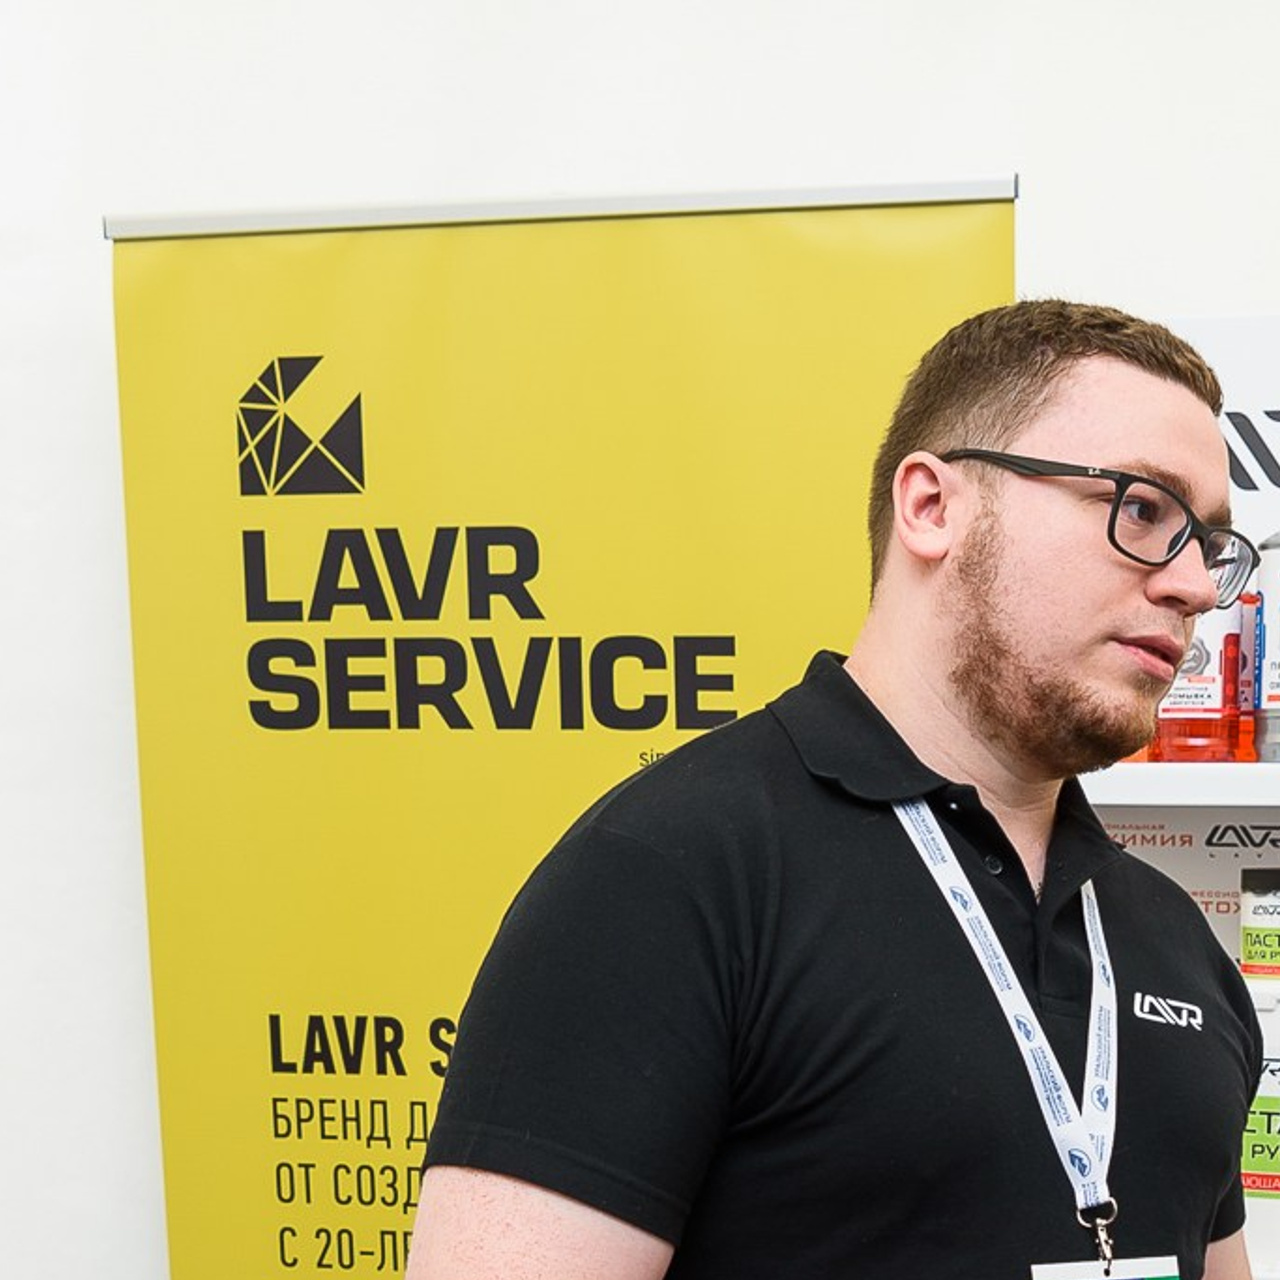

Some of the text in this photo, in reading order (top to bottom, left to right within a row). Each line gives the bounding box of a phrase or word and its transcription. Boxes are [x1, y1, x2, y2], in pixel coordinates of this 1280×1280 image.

[241, 526, 546, 622] LAVR
[246, 635, 738, 731] SERVICE
[1134, 991, 1203, 1031] LAVR
[269, 1014, 407, 1076] LAVR
[272, 1098, 391, 1149] БРЕНД
[275, 1162, 316, 1204] ОТ
[279, 1227, 298, 1268] С
